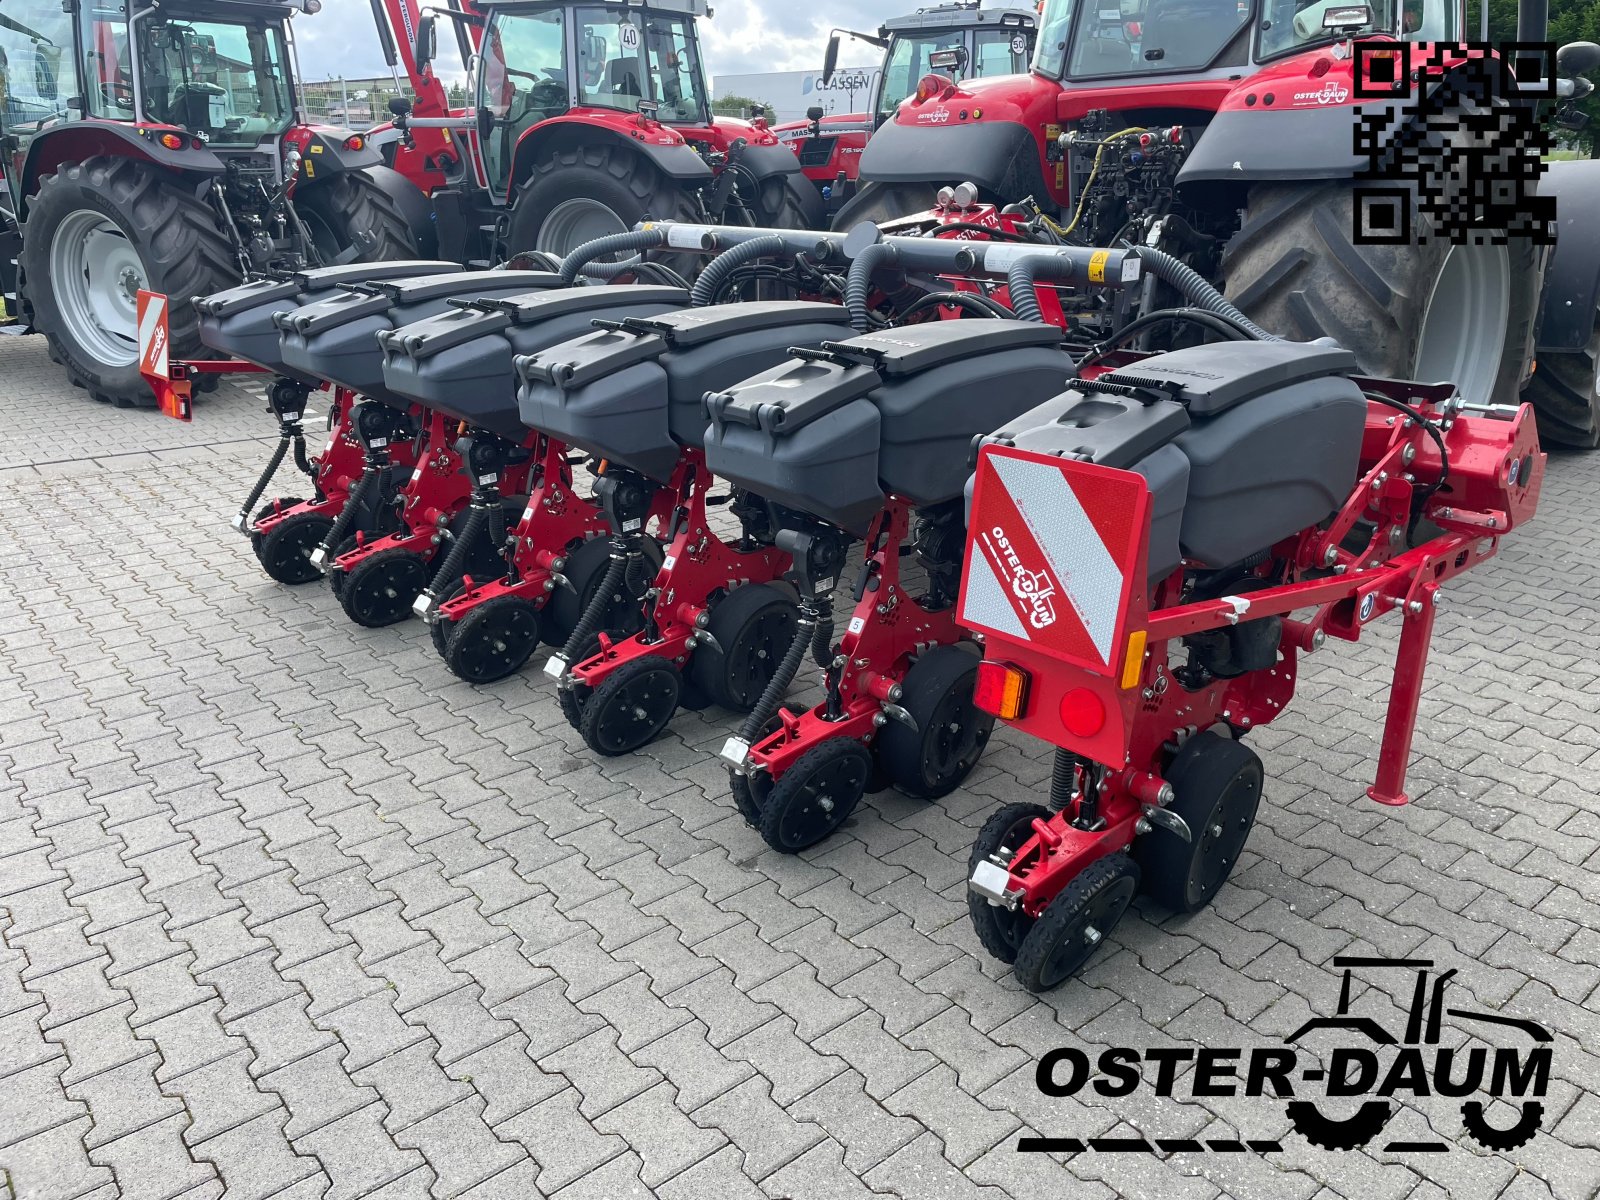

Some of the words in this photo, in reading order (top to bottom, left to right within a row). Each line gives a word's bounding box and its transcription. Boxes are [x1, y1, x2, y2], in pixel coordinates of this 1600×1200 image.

[623, 28, 637, 45] 40
[1013, 40, 1024, 49] 50
[1293, 90, 1349, 100] OSTER-DAUM
[791, 129, 812, 137] MASS
[985, 212, 999, 226] TX
[992, 526, 1054, 627] OSTER-DAUM
[853, 620, 860, 630] 5
